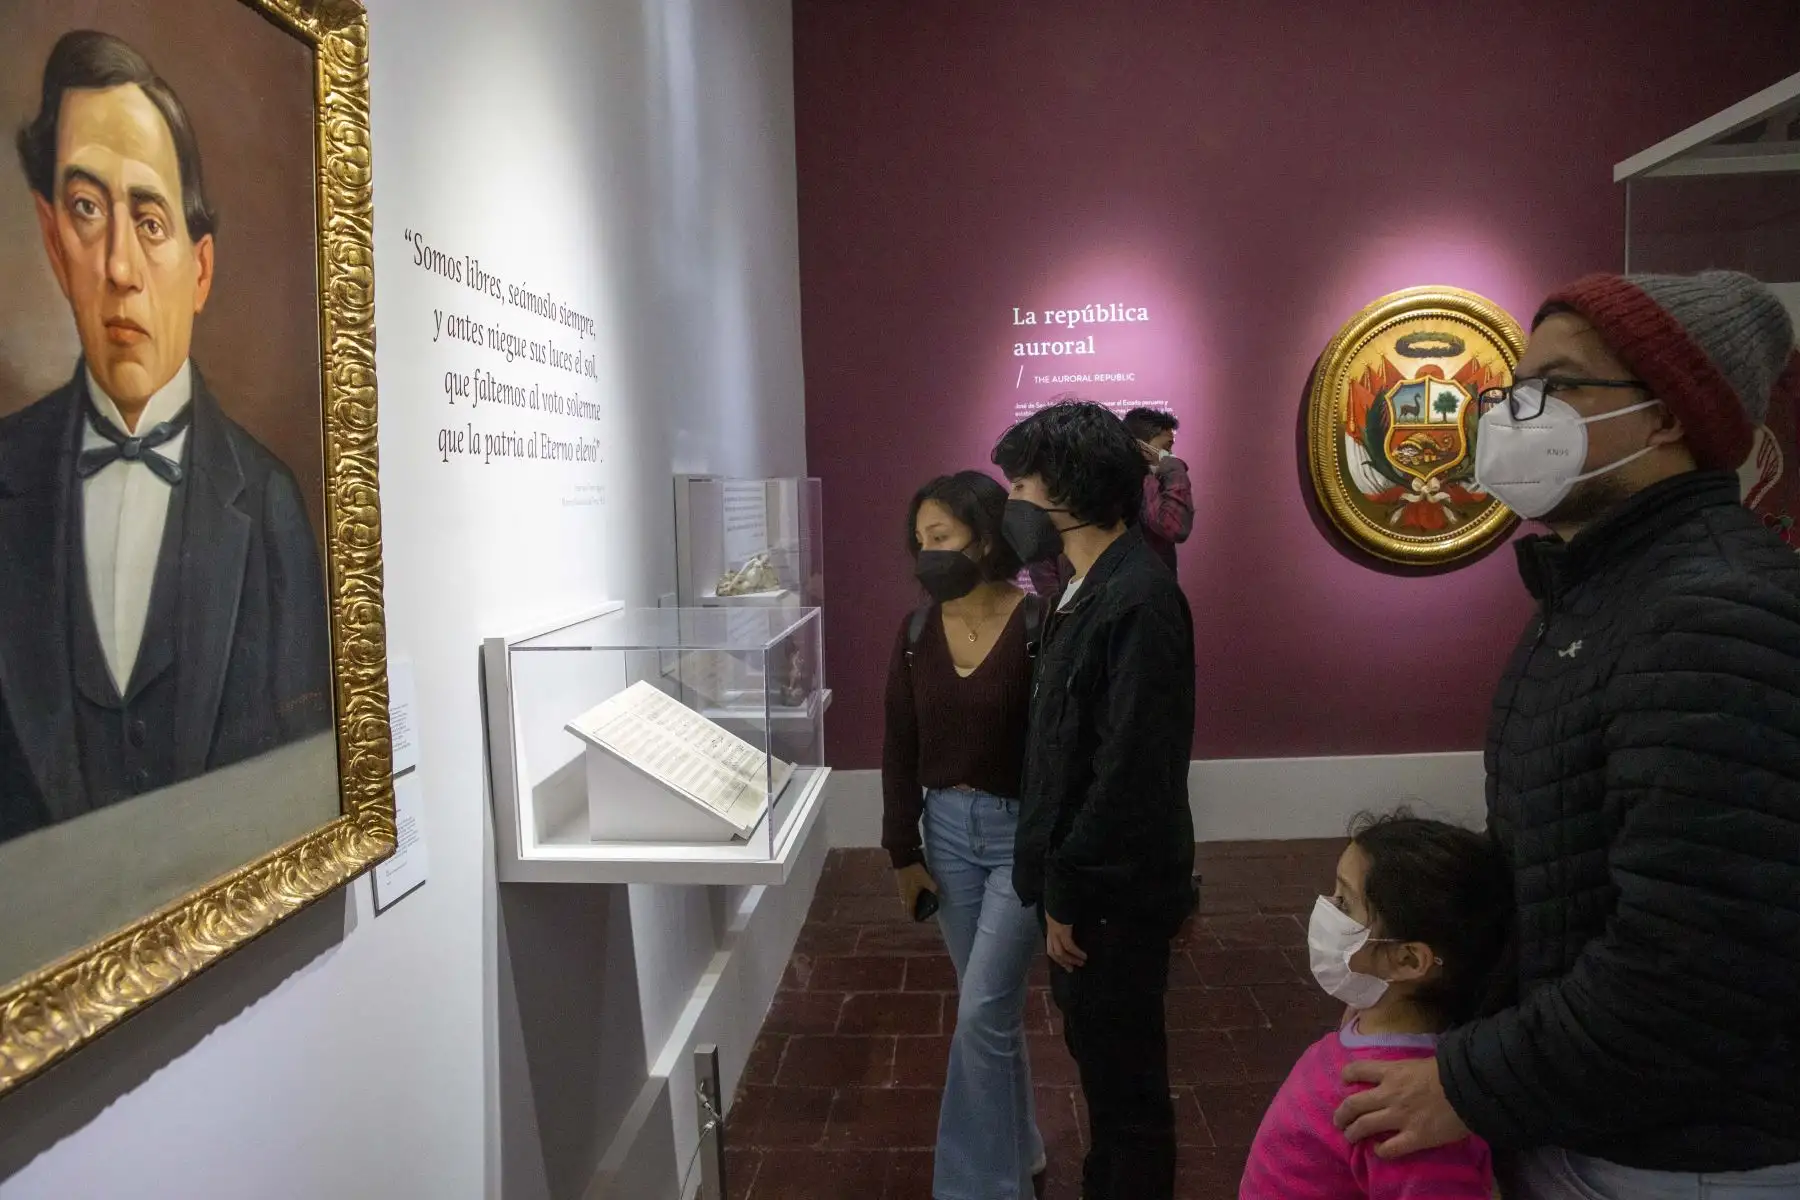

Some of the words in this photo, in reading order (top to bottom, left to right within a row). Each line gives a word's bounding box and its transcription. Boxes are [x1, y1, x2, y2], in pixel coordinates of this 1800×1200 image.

[404, 227, 462, 283] “Somos
[465, 255, 505, 306] libres,
[508, 281, 557, 321] seámoslo
[559, 301, 596, 340] siempre,
[1012, 307, 1037, 326] La
[1044, 303, 1149, 328] república
[433, 308, 443, 342] y
[447, 314, 484, 346] antes
[487, 322, 527, 363] niegue
[529, 341, 546, 364] sus
[548, 339, 573, 372] luces
[574, 349, 582, 375] el
[584, 354, 598, 382] sol,
[1013, 335, 1095, 356] auroral
[444, 371, 470, 405] que
[472, 368, 526, 408] faltemos
[529, 383, 540, 411] al
[542, 391, 564, 415] voto
[566, 392, 601, 421] solemne
[1034, 375, 1050, 384] THE
[1052, 374, 1093, 384] AURORAL
[1094, 373, 1136, 383] REPUBLIC
[438, 428, 464, 463] que
[467, 422, 481, 455] la
[484, 430, 524, 465] patria
[527, 431, 538, 459] al
[540, 432, 573, 461] Eterno
